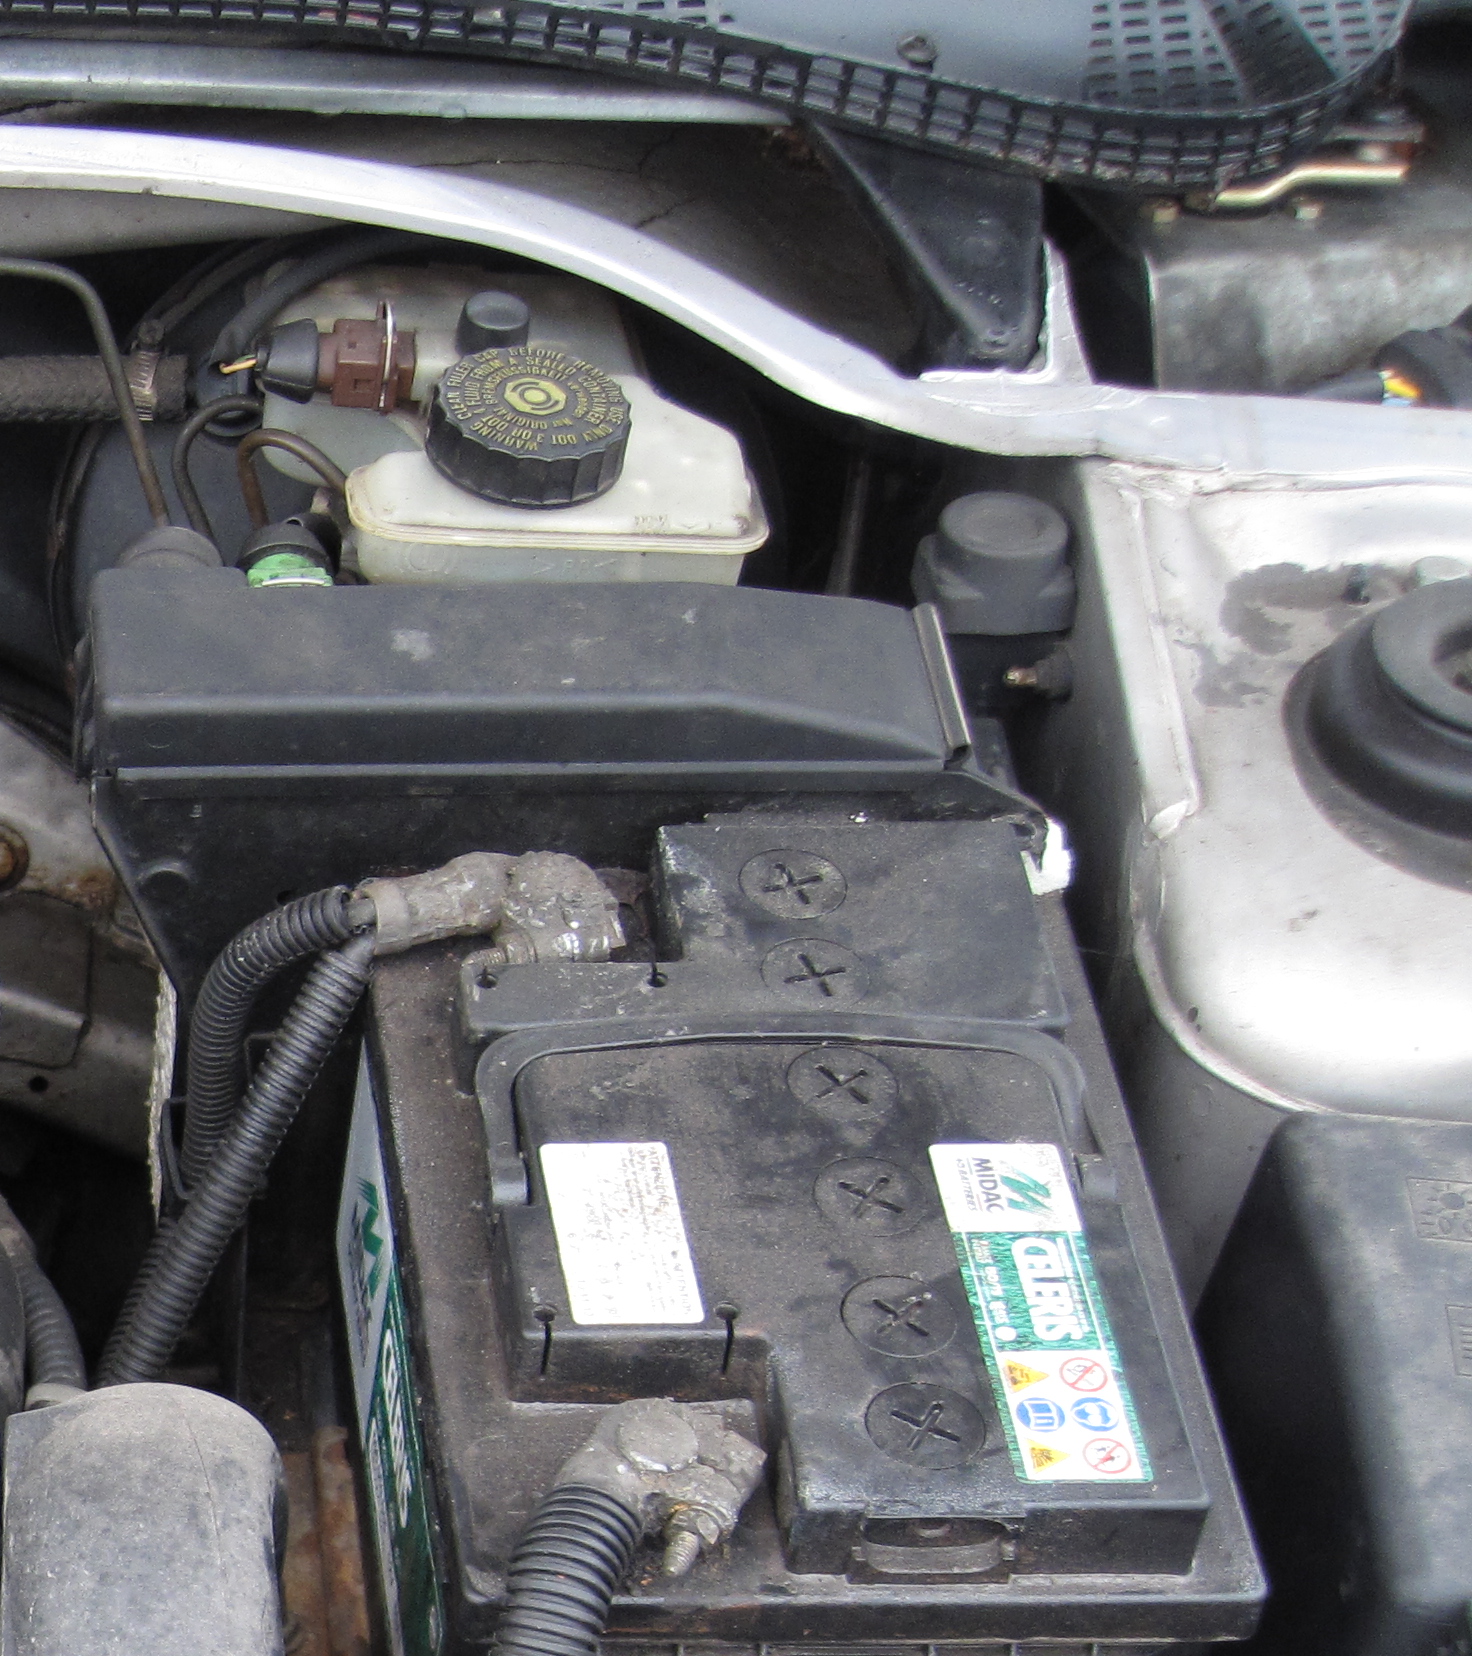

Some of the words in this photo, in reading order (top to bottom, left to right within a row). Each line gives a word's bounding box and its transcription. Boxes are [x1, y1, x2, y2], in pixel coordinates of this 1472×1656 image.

[473, 350, 499, 362] CAP
[508, 358, 517, 366] A
[509, 348, 565, 361] BEFORE
[447, 362, 474, 387] FILLER
[471, 360, 504, 378] FROM
[526, 357, 577, 374] SEALED
[575, 360, 623, 403] REMOVING
[464, 382, 481, 406] FLUID
[578, 375, 607, 425] CONTAINER
[446, 392, 472, 420] CLEAN
[482, 416, 509, 431] DOT
[493, 406, 548, 430] ORIGINAL
[610, 407, 624, 425] USE
[470, 422, 539, 451] WARNING
[511, 429, 532, 439] OR
[537, 435, 545, 443] 3
[551, 435, 577, 445] DOT
[582, 425, 613, 442] ONLY
[972, 1157, 1005, 1213] MIDAC
